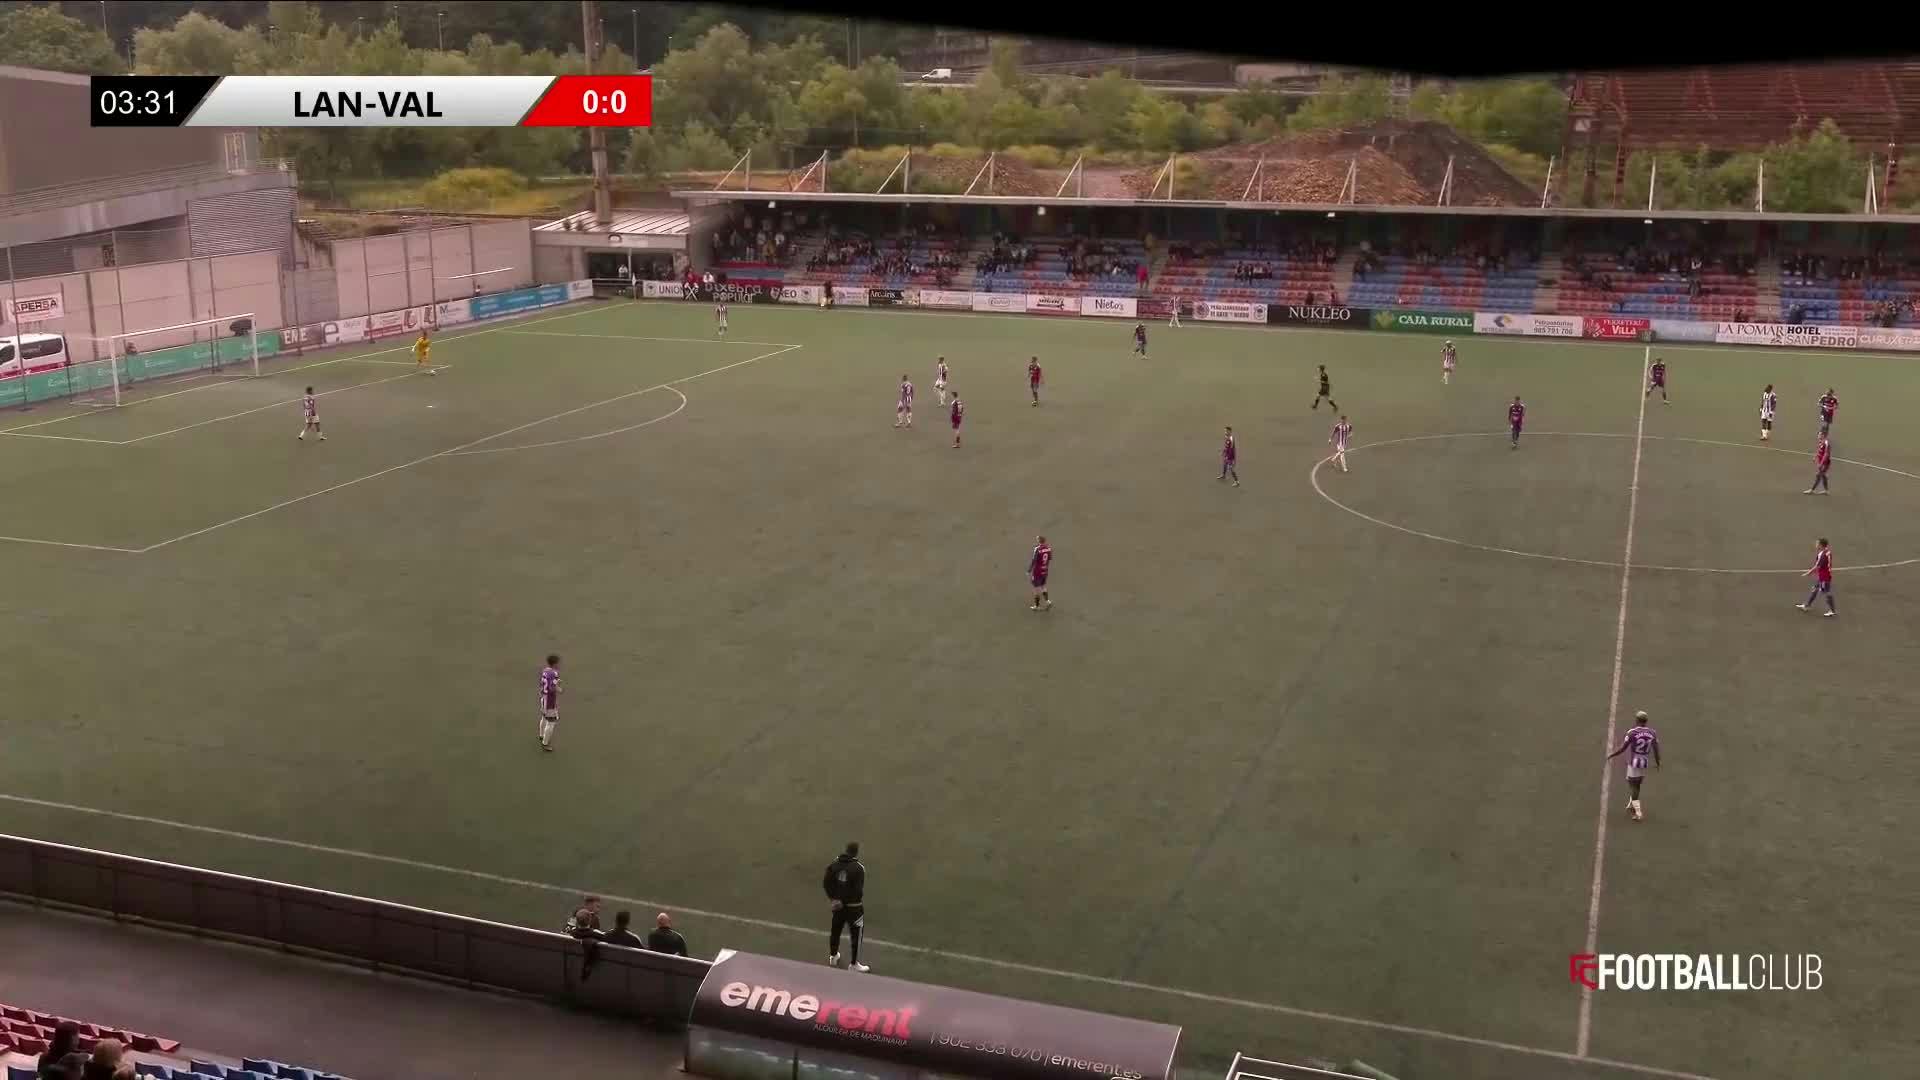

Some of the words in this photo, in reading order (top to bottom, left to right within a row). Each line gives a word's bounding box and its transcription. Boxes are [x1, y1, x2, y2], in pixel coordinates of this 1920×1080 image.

[1288, 306, 1351, 320] NUKLEO
[1399, 315, 1427, 325] CAJA
[1431, 316, 1473, 327] RURAL
[1717, 323, 1734, 335] LA
[1737, 324, 1785, 337] POMAR
[1787, 325, 1821, 335] HOTEL
[719, 981, 917, 1040] emerent
